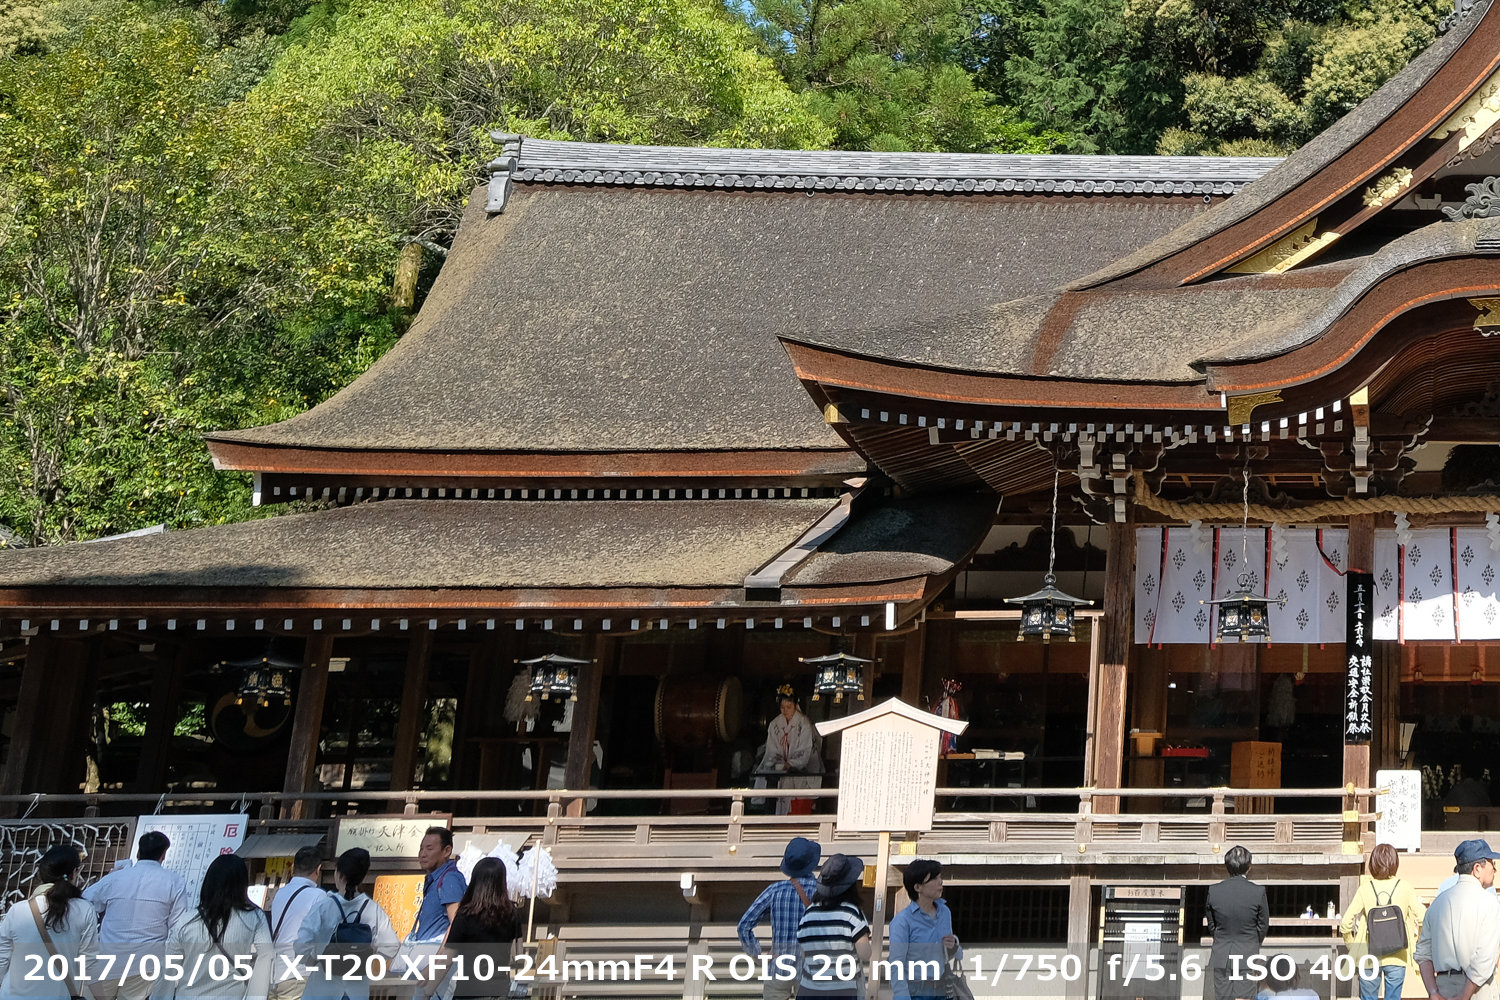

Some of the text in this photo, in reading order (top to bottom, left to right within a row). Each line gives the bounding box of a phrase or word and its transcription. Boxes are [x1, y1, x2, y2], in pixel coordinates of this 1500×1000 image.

[1346, 654, 1359, 734] 交通安全祈願祭
[346, 824, 427, 839] 願掛け天津金
